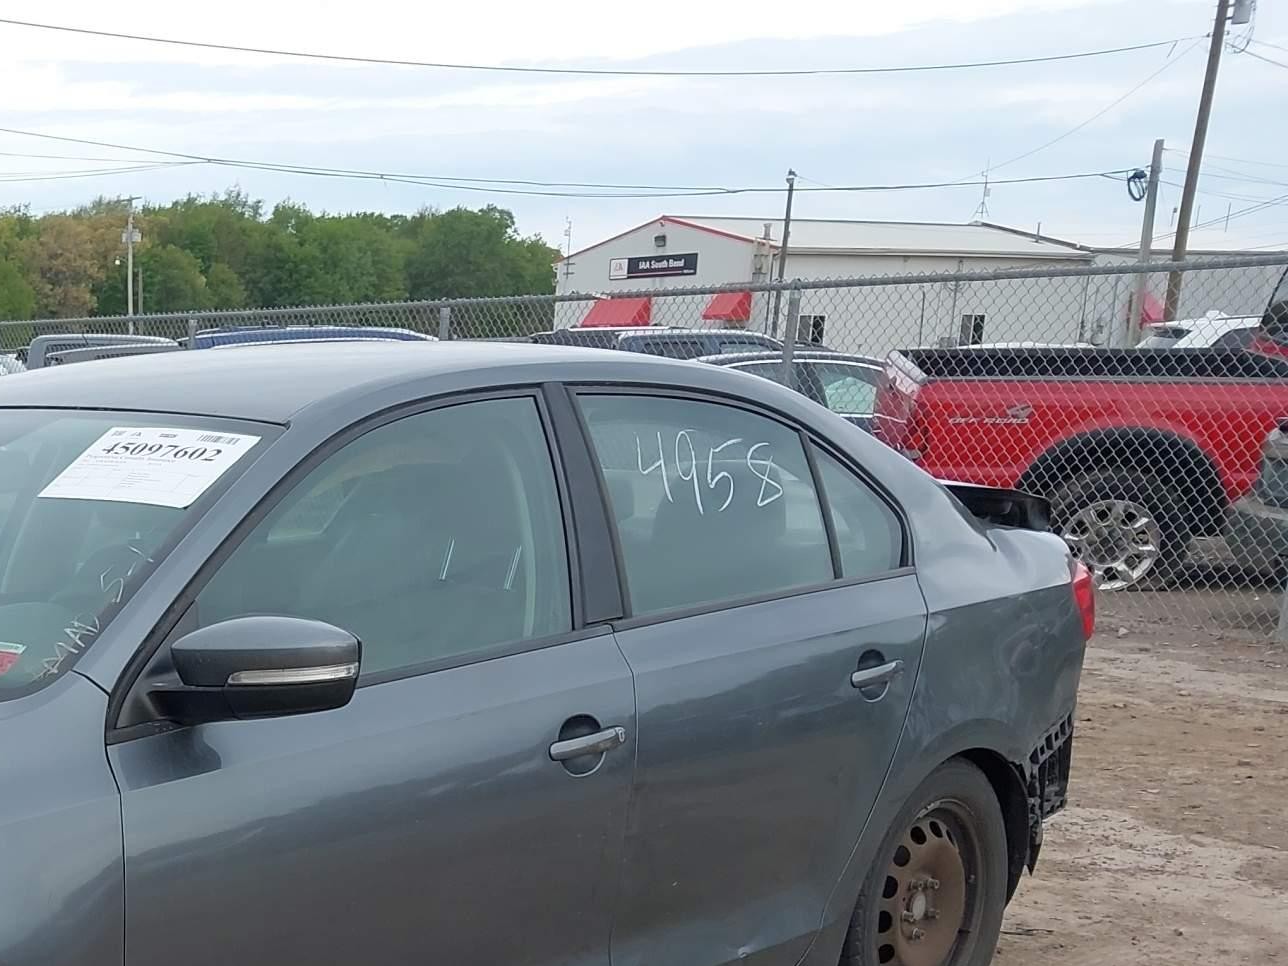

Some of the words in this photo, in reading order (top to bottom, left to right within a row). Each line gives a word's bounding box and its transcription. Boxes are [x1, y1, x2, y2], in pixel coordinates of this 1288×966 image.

[639, 260, 650, 269] IAA
[102, 441, 223, 462] 45097602
[633, 429, 784, 515] 4958
